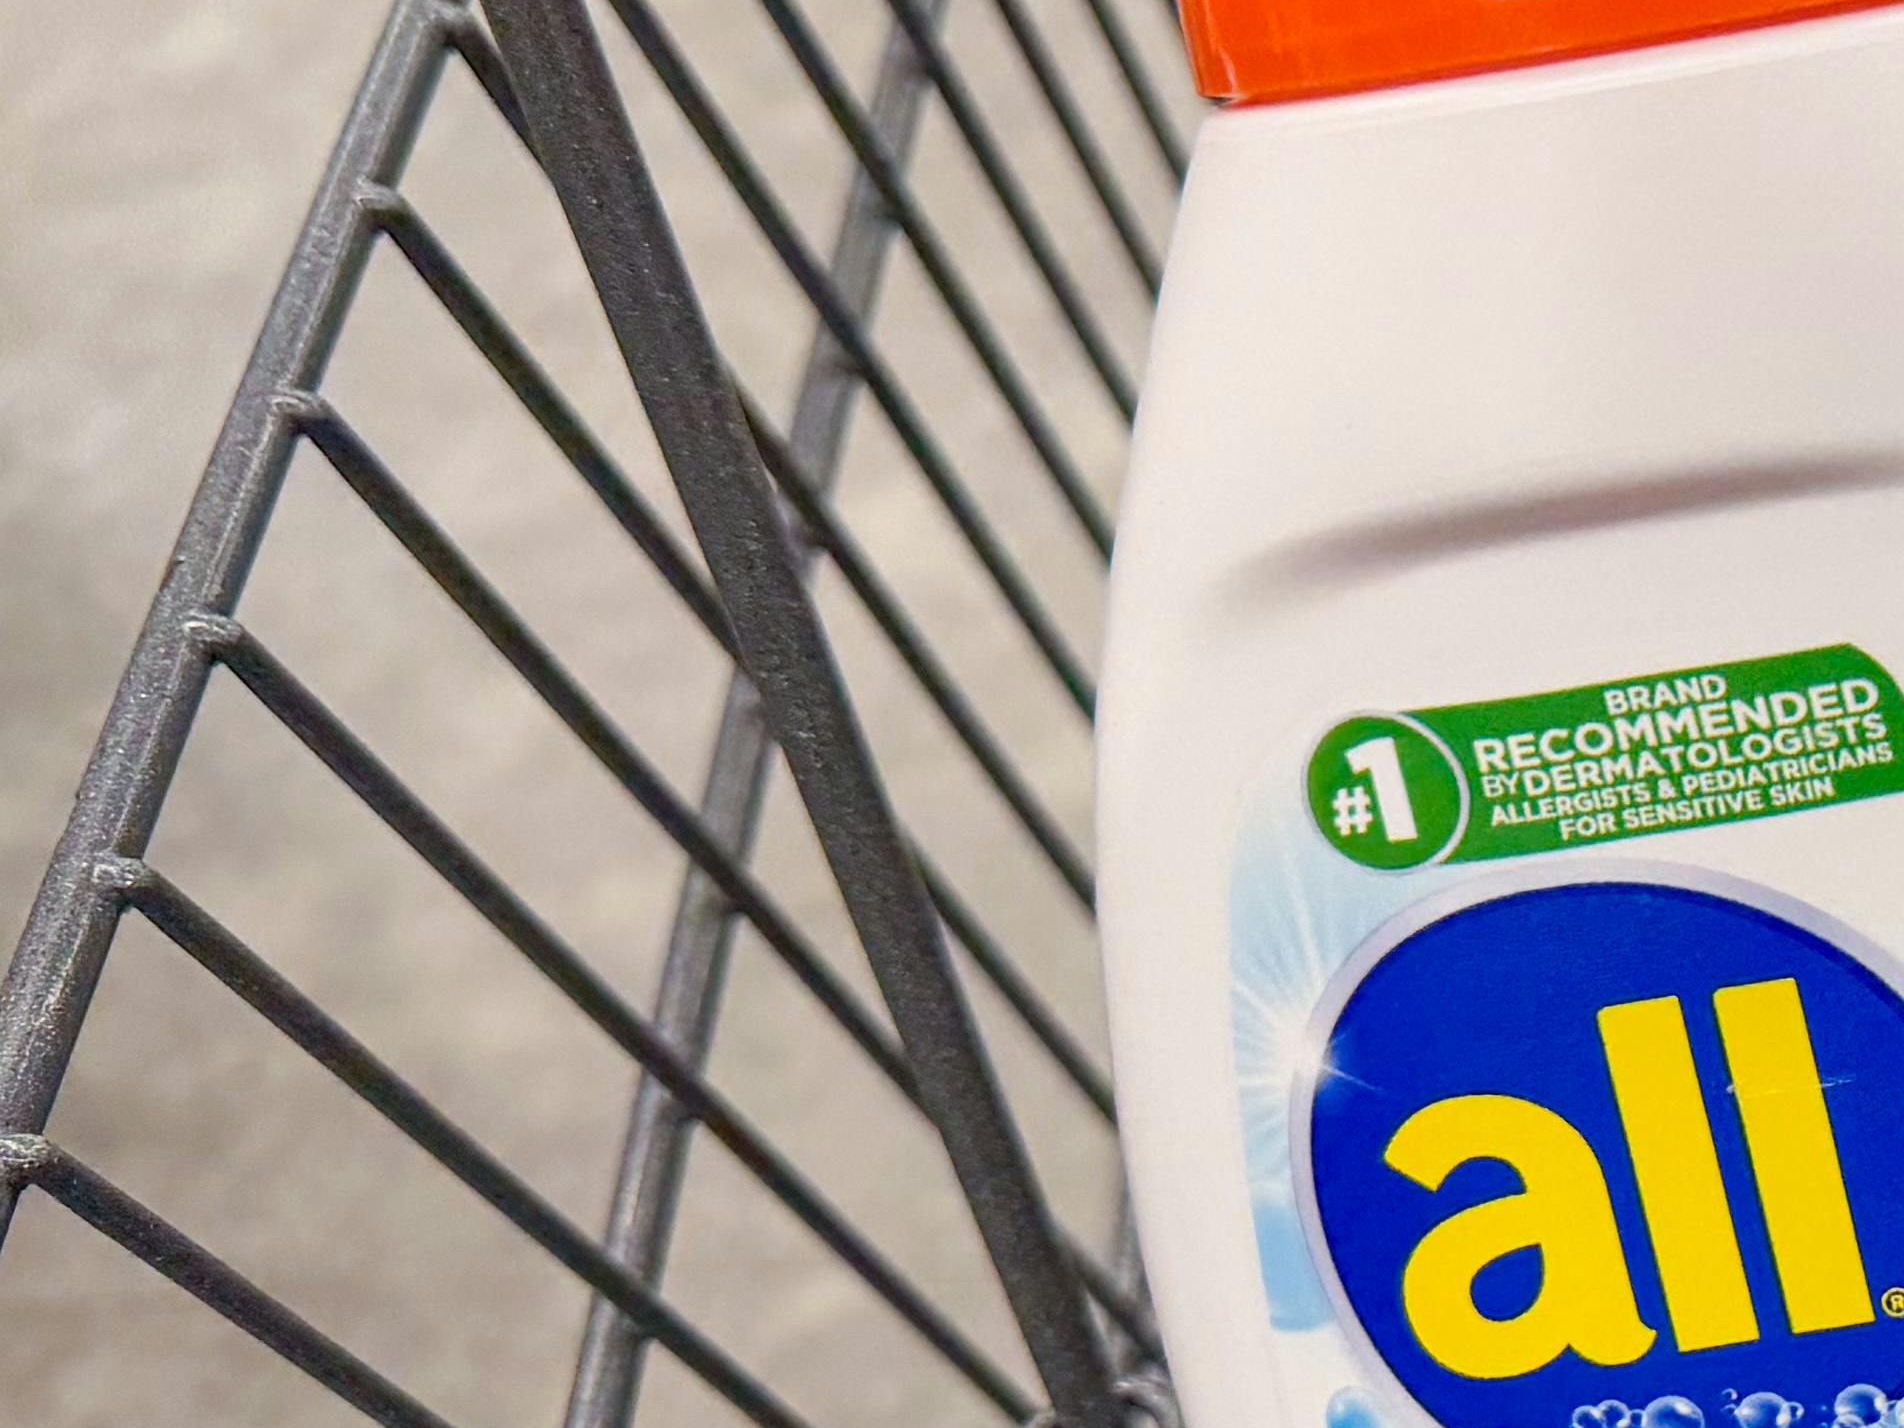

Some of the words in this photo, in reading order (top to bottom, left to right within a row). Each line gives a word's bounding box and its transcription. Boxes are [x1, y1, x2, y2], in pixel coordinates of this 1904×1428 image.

[1473, 676, 1880, 774] RECOMMENDED
[1603, 673, 1727, 718] BRAND
[1331, 735, 1418, 843] #1
[1482, 771, 1519, 800] BY
[1524, 712, 1888, 797] DERMATOLOGISTS
[1491, 781, 1653, 828] ALLERGISTS
[1656, 777, 1677, 802] &
[1681, 742, 1895, 798] PEDIATRICIANS
[1558, 811, 1619, 841] FOR
[1623, 789, 1766, 832] SENSITIVE
[1769, 775, 1838, 807] SKIN
